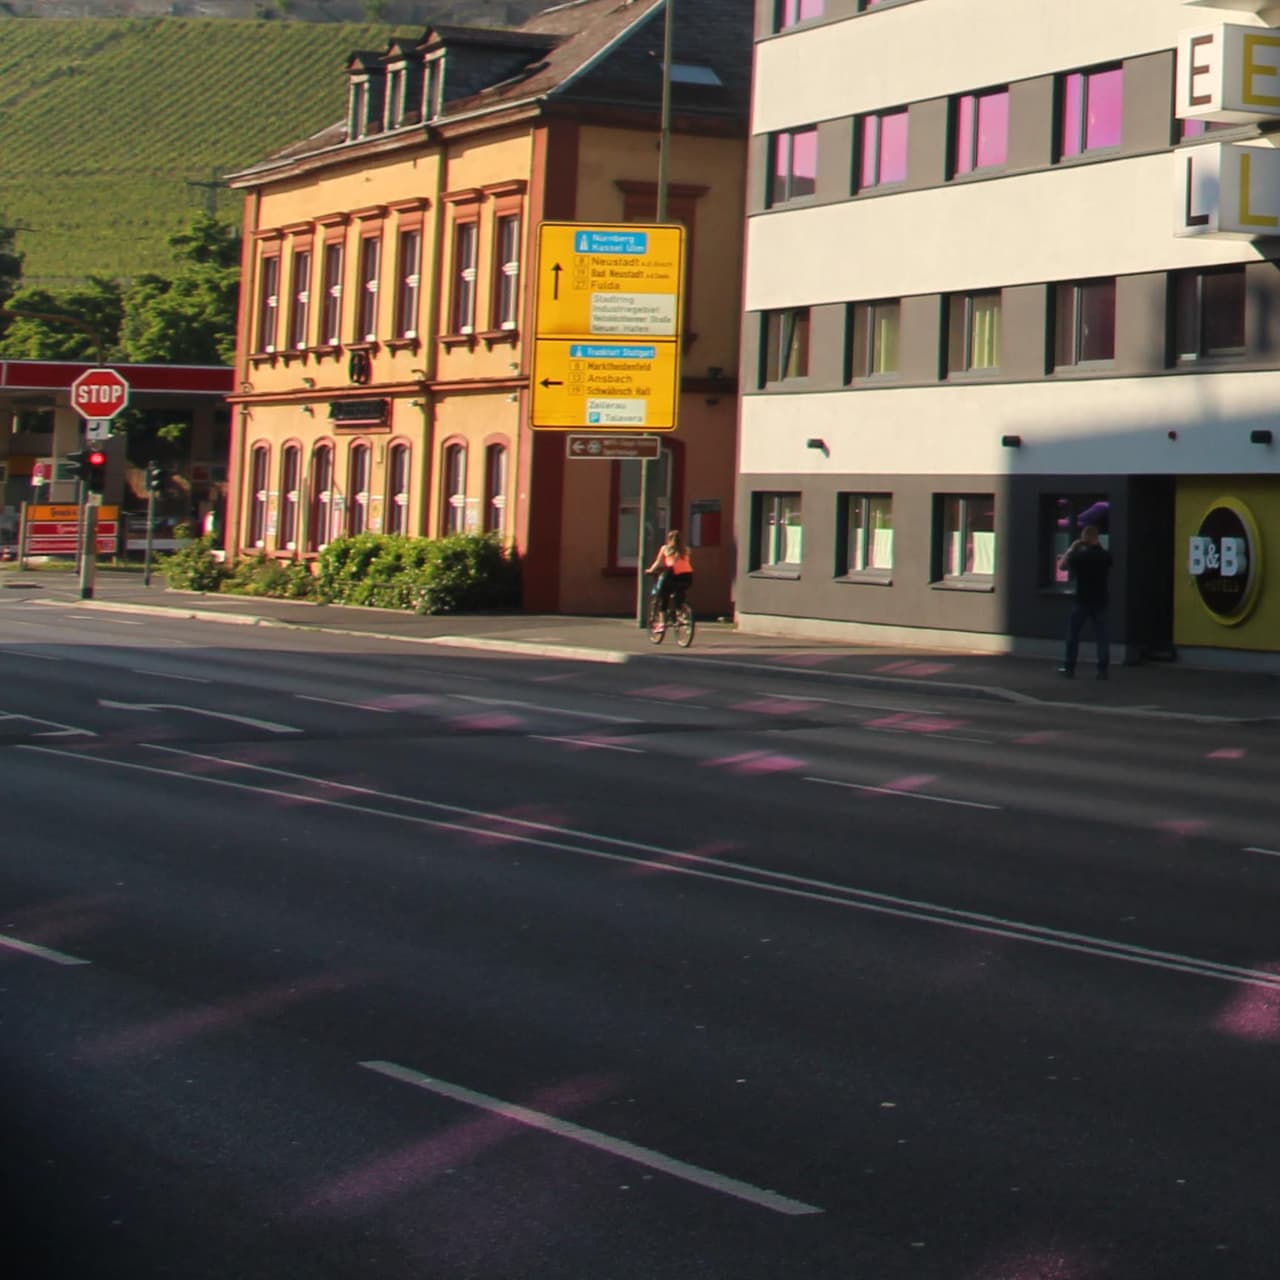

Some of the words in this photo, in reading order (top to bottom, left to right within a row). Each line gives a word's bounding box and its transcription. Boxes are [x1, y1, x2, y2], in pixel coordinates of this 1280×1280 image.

[591, 280, 620, 290] Fulda
[587, 374, 633, 384] Ansbach
[78, 384, 122, 404] STOP
[1188, 535, 1247, 577] B&B
